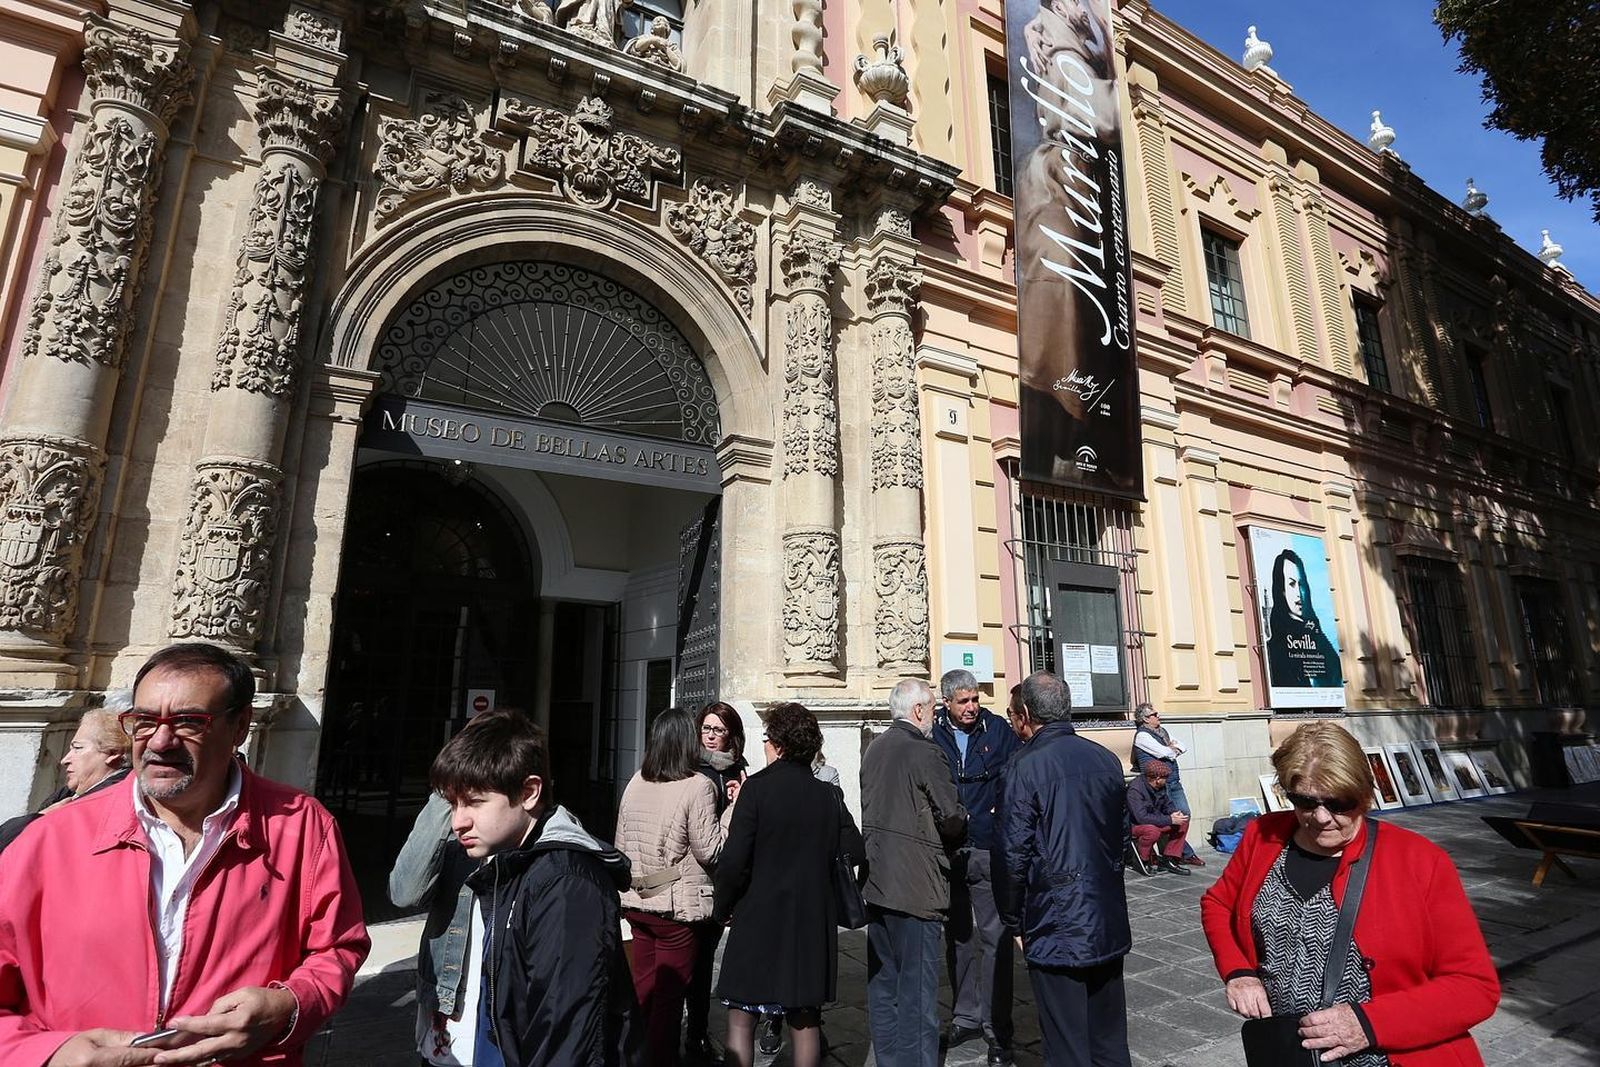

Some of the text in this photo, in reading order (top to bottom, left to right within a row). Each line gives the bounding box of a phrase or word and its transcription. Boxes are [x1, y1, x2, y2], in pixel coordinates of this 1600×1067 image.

[1019, 53, 1112, 346] Murillo
[1113, 271, 1130, 350] Cuarto
[381, 409, 710, 477] MUSEO DE BELLAS ARTES
[1286, 634, 1317, 650] Sevilla
